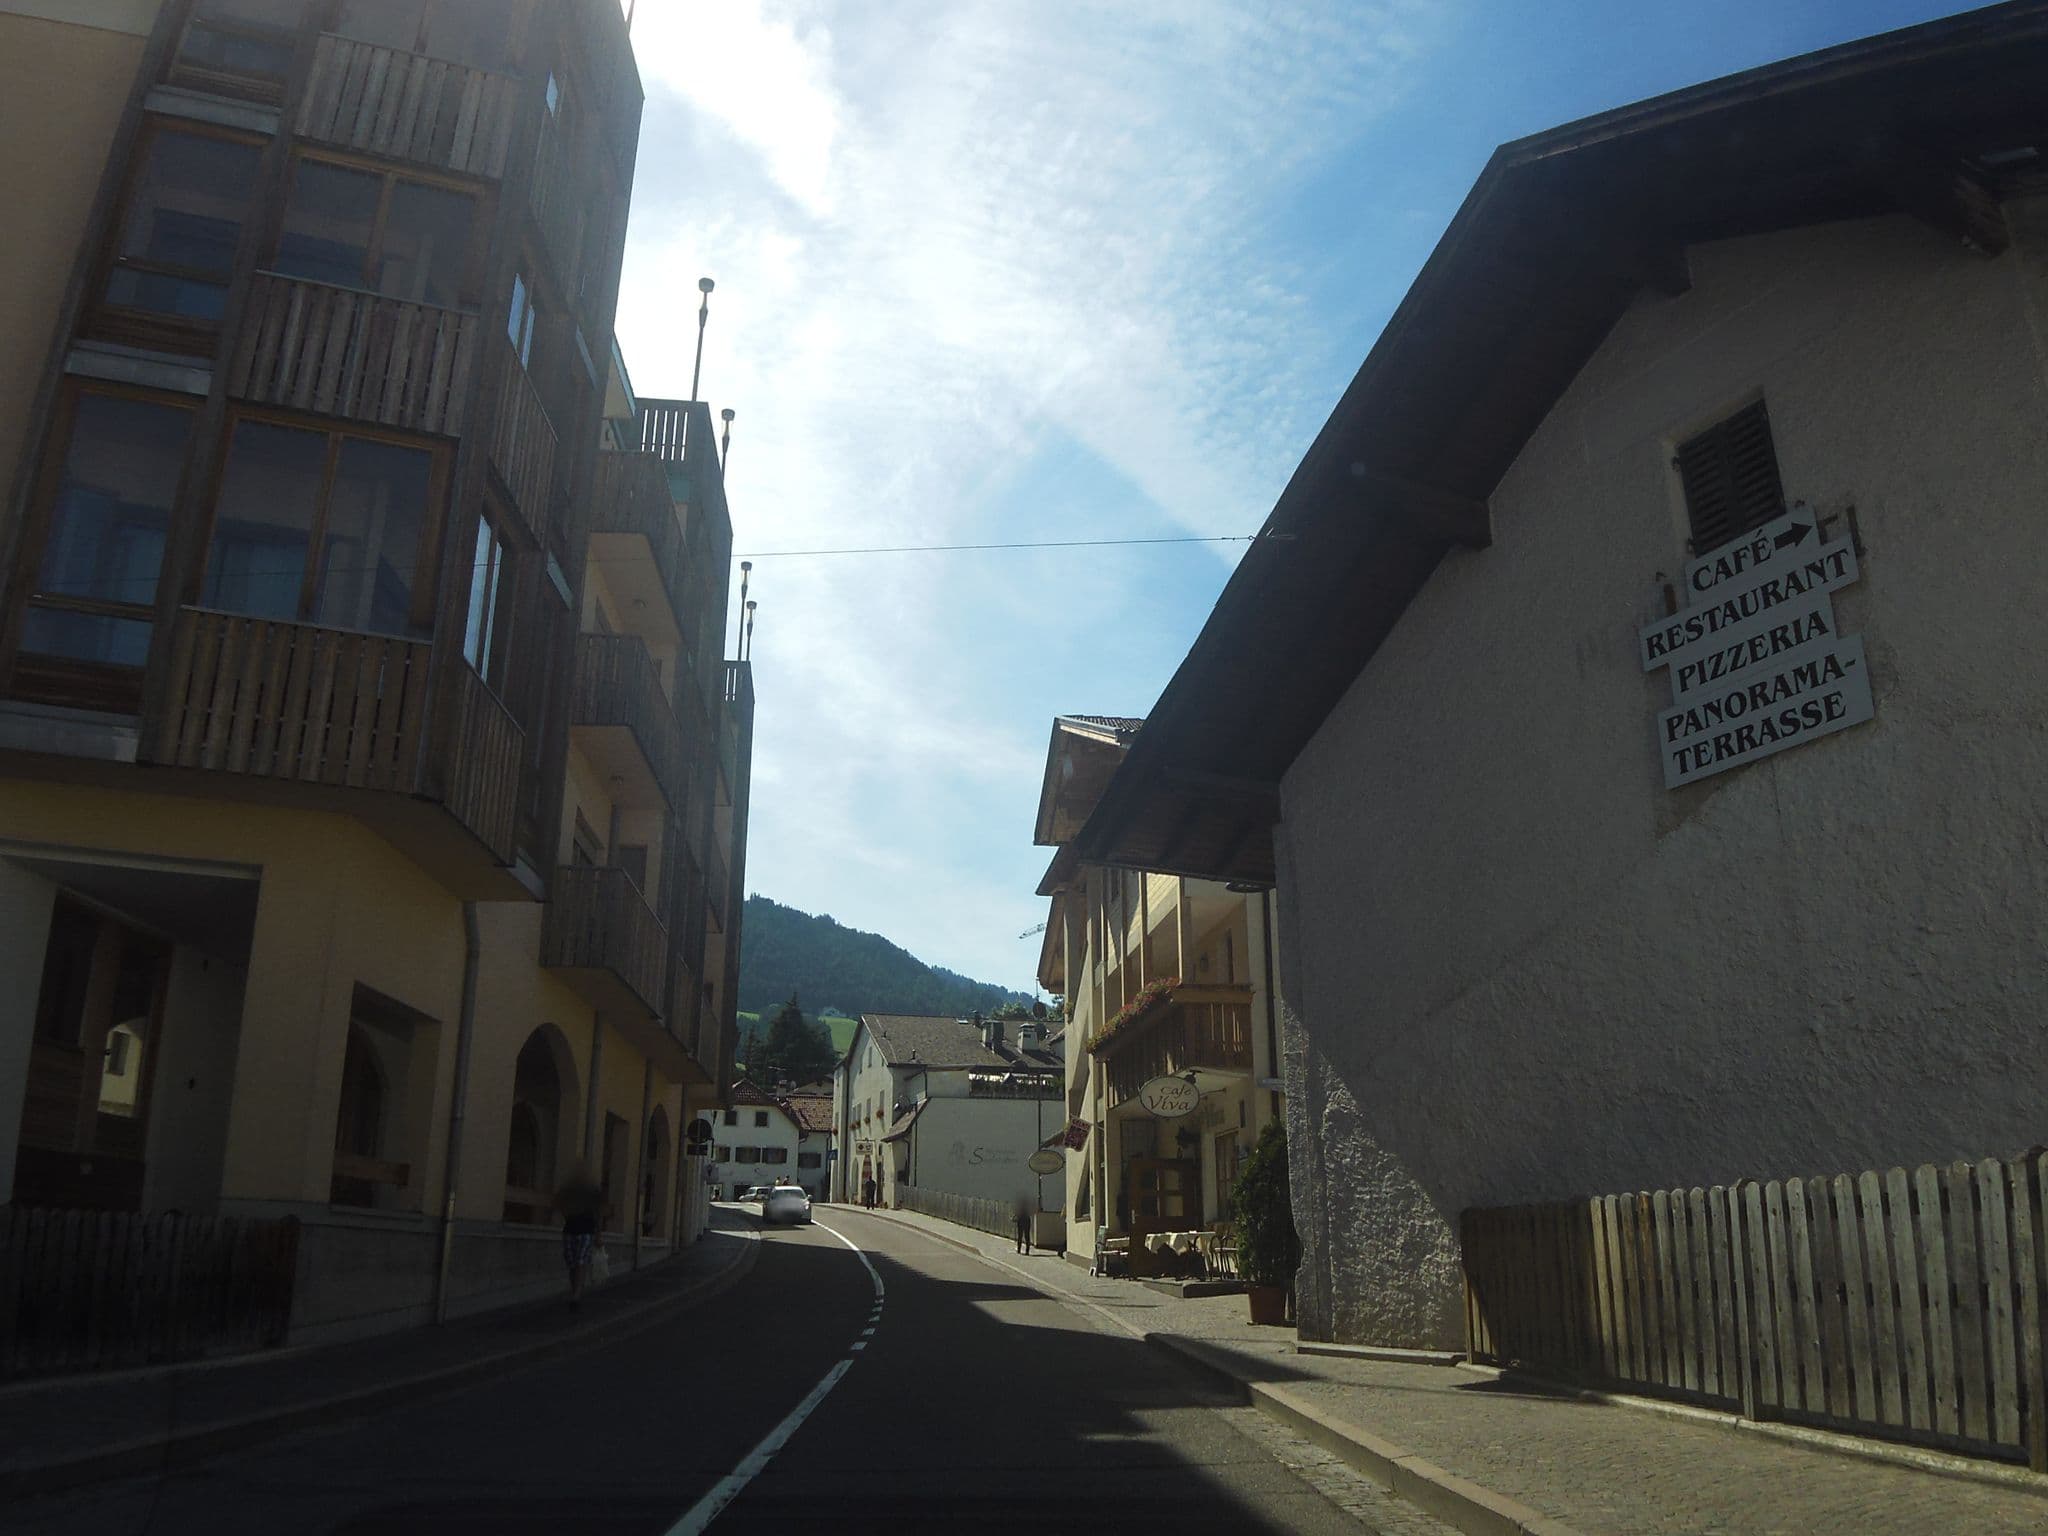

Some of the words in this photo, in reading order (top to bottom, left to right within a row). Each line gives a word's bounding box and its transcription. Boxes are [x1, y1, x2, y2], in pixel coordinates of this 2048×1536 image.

[1692, 528, 1772, 592] CAFÉ
[1645, 548, 1849, 661] RESTAURANT
[1677, 610, 1829, 693] PIZZERIA
[1666, 652, 1857, 743] PANORAMA-
[1673, 690, 1846, 775] TERRASSE
[1148, 1095, 1191, 1111] Viva
